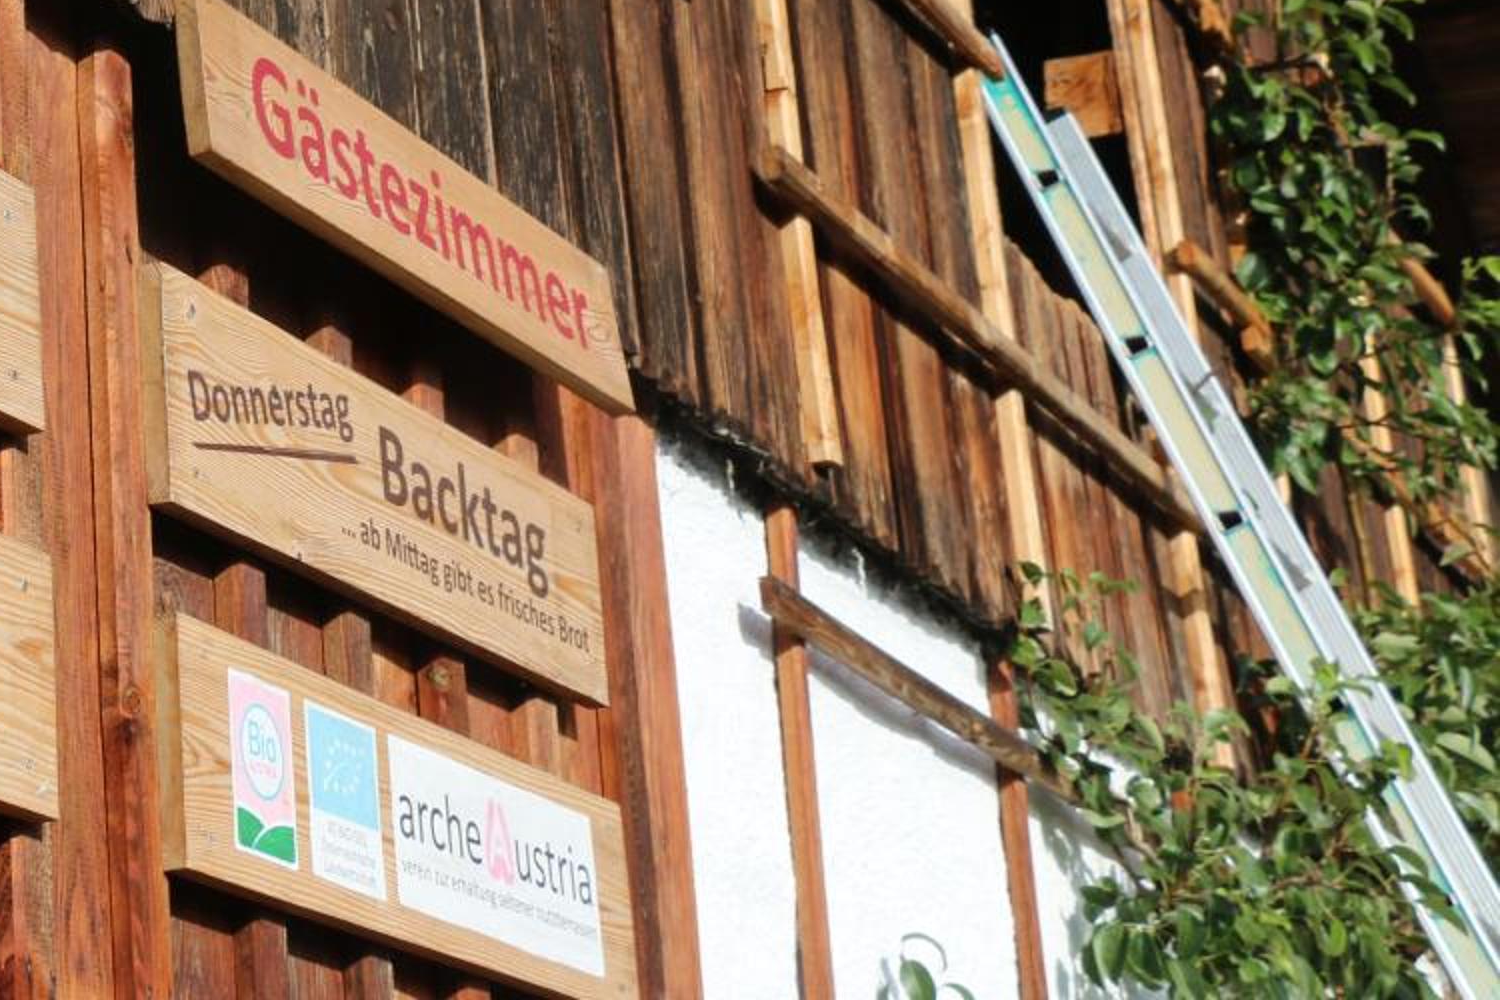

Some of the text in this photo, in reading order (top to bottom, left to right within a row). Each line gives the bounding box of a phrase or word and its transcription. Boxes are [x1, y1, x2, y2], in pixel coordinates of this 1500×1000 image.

[251, 56, 588, 350] Gästezimmer
[187, 369, 355, 443] Donnerstag
[378, 424, 550, 599] Backtag
[360, 518, 381, 551] ab
[385, 526, 440, 587] Mittag
[443, 560, 474, 593] gibt
[478, 581, 495, 607] es
[498, 582, 555, 636] frisches
[558, 615, 590, 653] Brot
[247, 720, 277, 764] Bio
